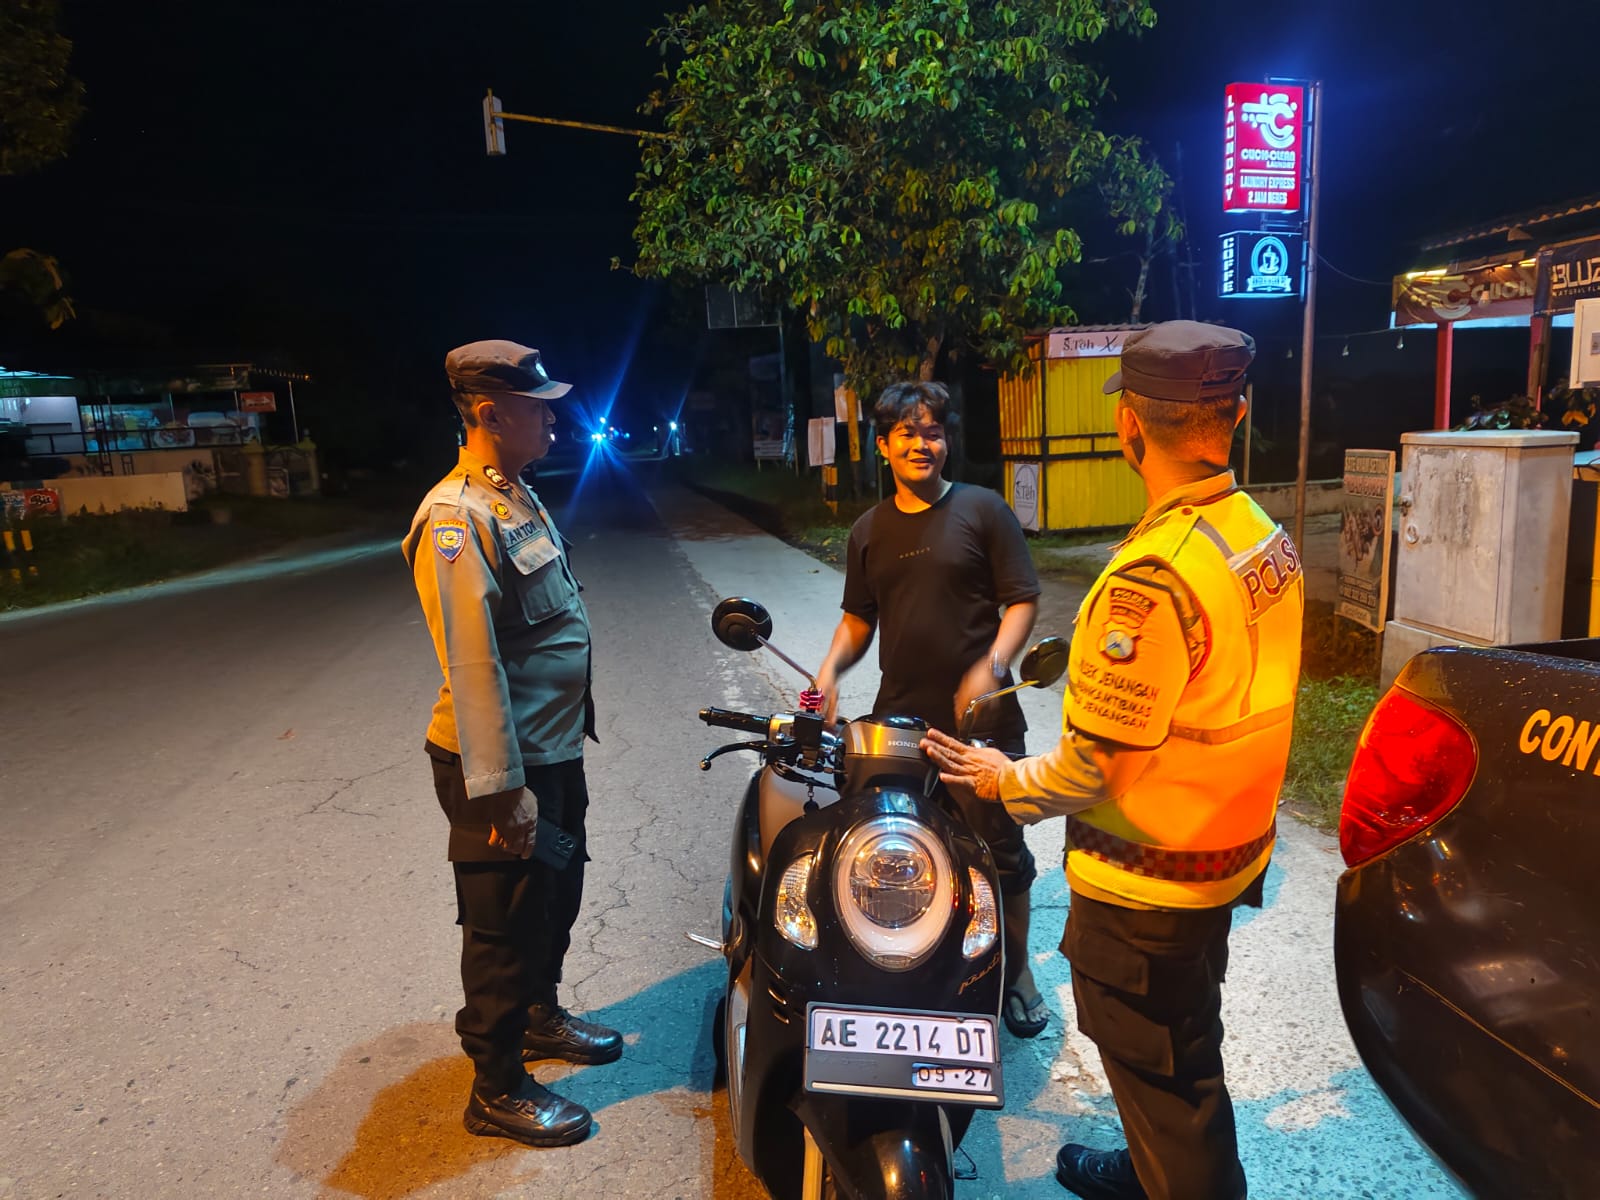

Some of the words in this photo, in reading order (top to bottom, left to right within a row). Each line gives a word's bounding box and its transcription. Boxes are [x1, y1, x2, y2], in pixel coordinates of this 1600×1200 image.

[1225, 95, 1234, 200] LAUNDRY
[1223, 237, 1234, 293] COFFE
[887, 740, 920, 749] HOND
[1519, 708, 1600, 777] CON
[820, 1018, 858, 1048] AE
[875, 1021, 942, 1054] 2214
[955, 1027, 986, 1057] DT
